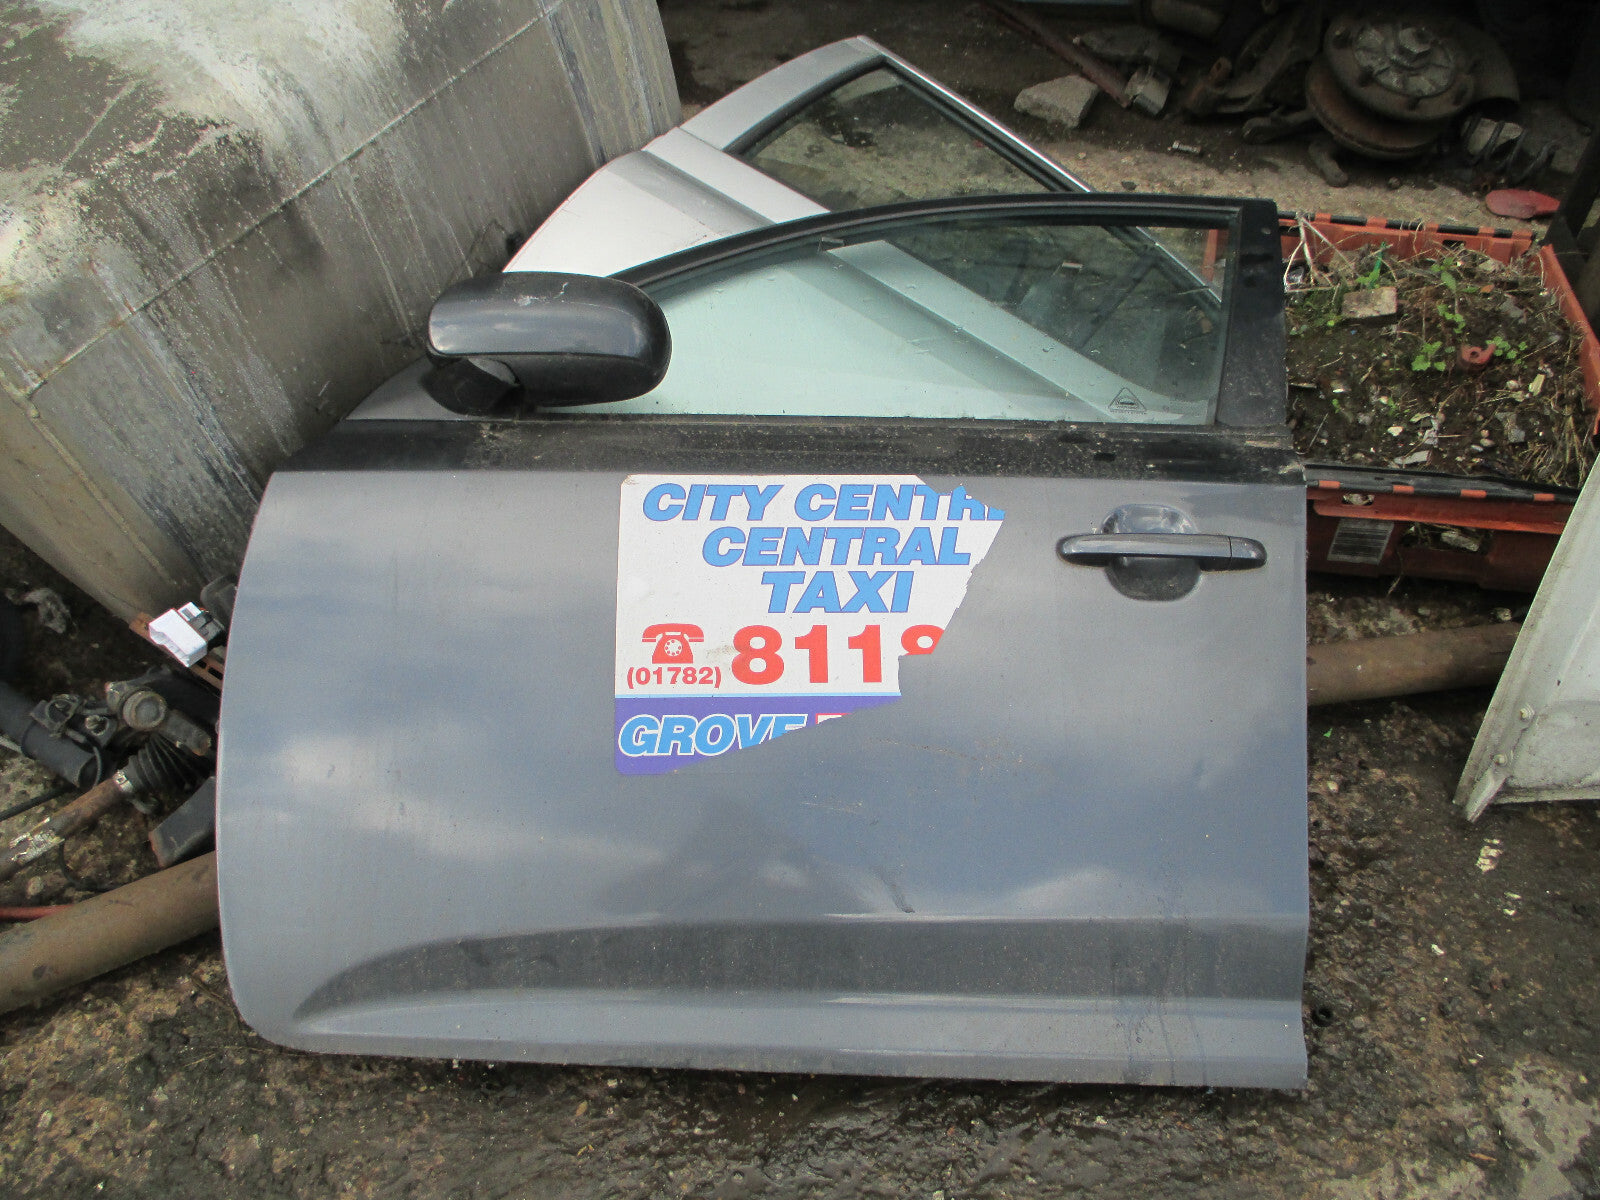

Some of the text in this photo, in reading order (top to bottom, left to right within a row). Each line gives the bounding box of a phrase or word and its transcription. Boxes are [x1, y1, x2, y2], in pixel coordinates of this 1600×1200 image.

[643, 483, 1006, 522] CITY CENTR
[702, 526, 972, 567] CENTRAL
[761, 571, 915, 614] TAXI
[626, 666, 722, 690] (01782)
